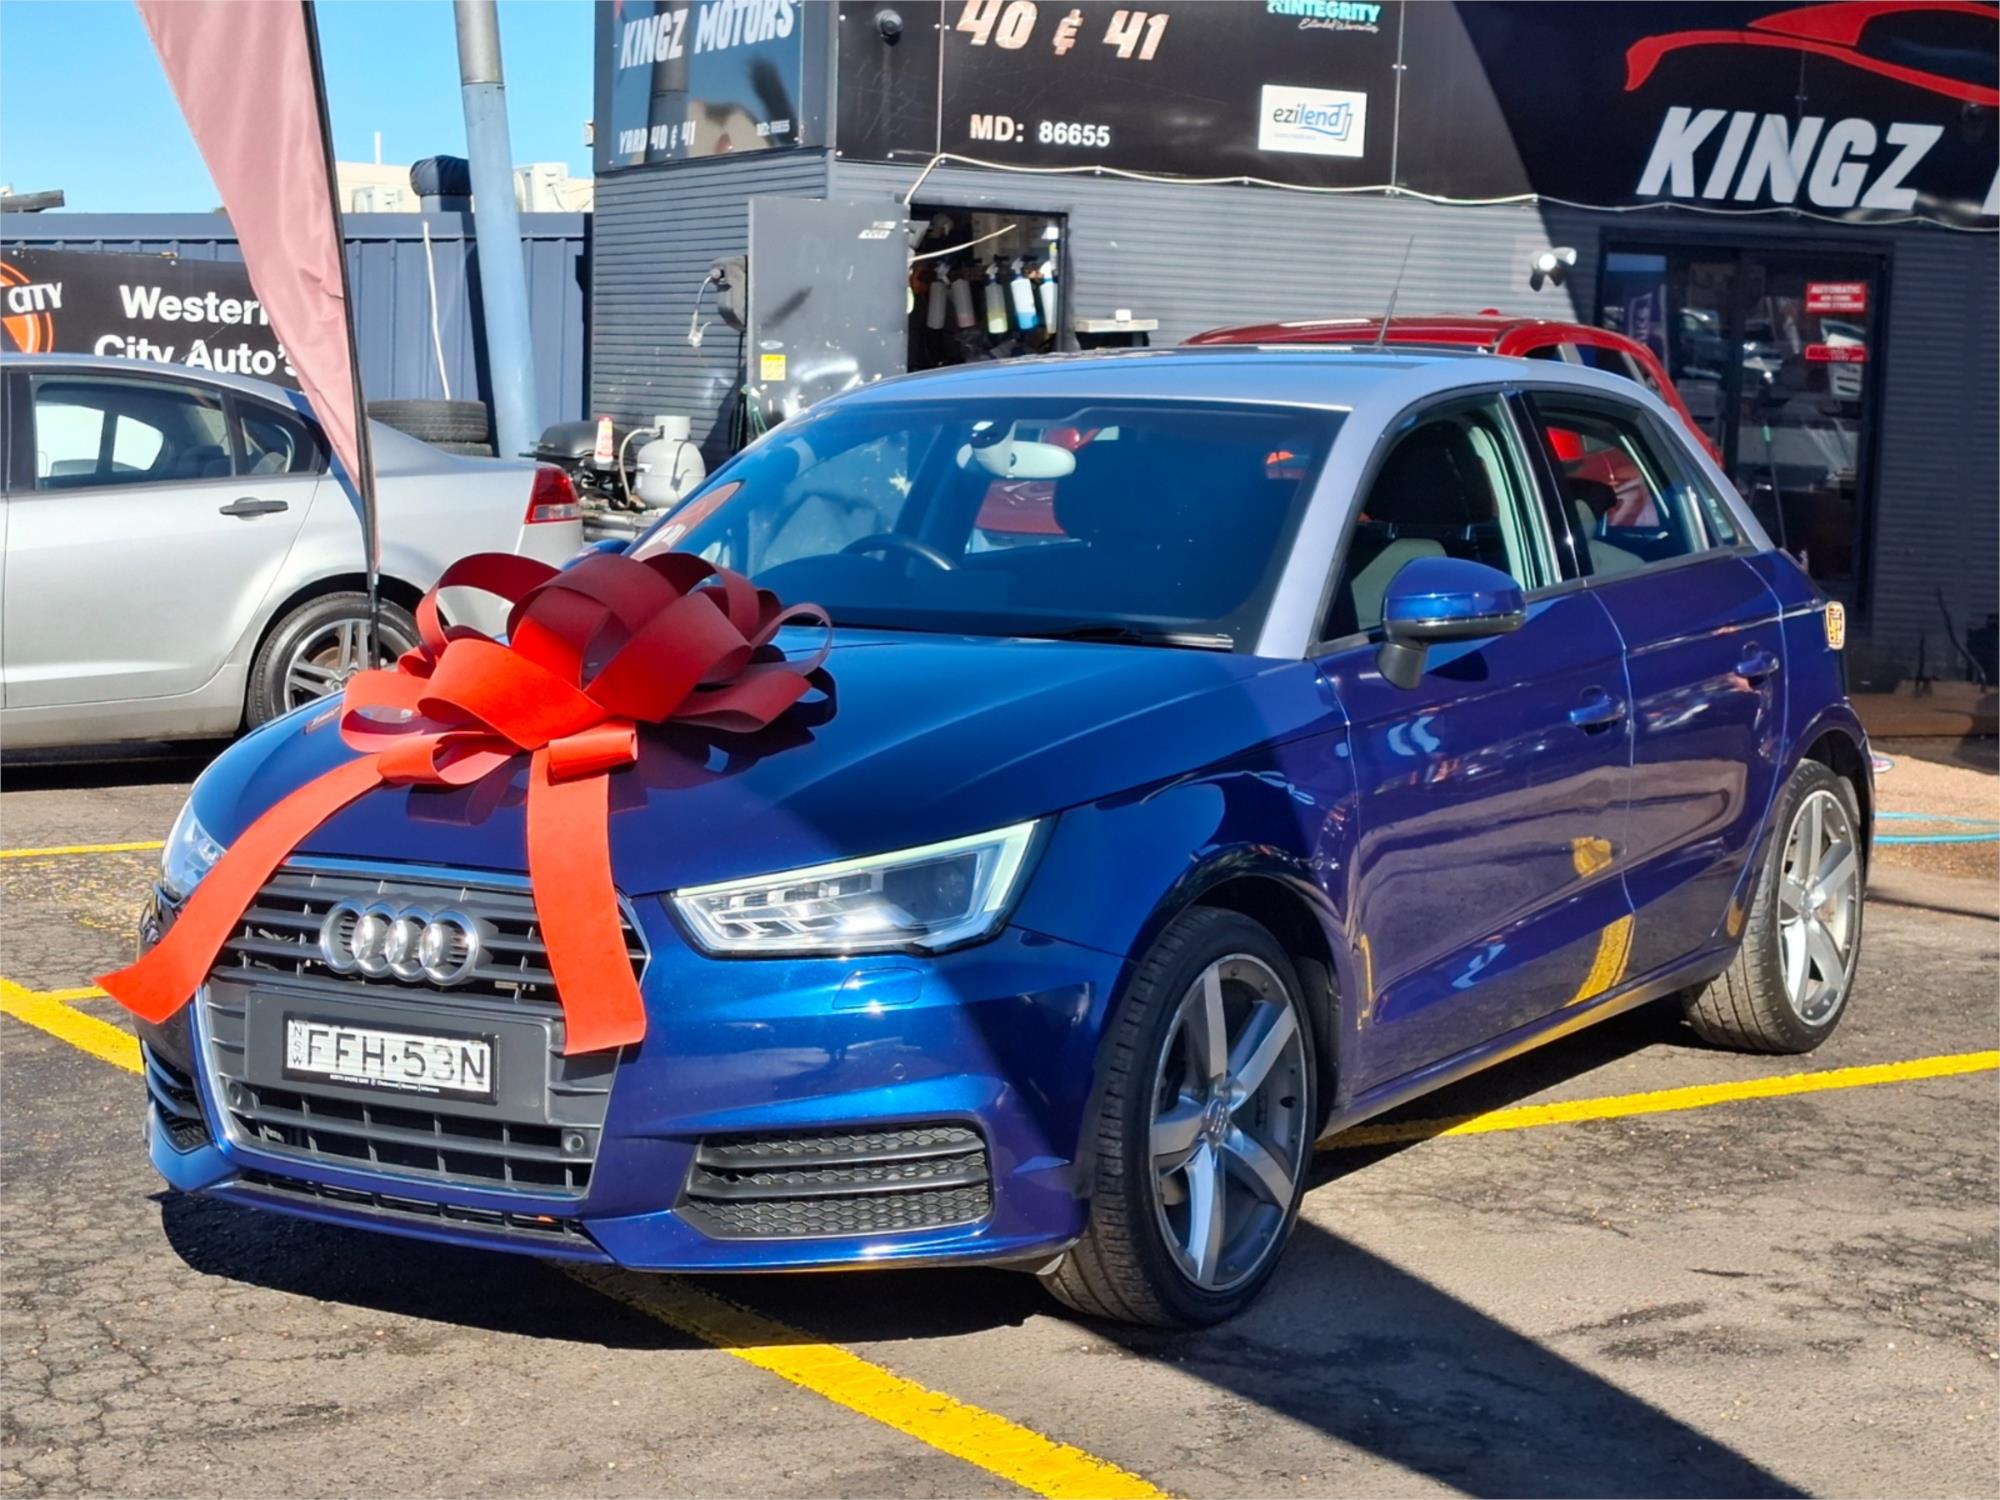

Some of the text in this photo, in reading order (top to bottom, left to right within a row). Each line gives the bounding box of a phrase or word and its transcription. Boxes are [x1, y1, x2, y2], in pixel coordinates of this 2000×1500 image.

[956, 0, 1038, 49] 40
[1102, 10, 1169, 60] 41
[1282, 0, 1381, 22] INTEGRITY
[620, 0, 794, 69] KINGZ MOTORS
[970, 114, 1110, 147] MD: 86655
[1273, 103, 1341, 127] ezilend
[1636, 106, 1945, 211] KINGZ
